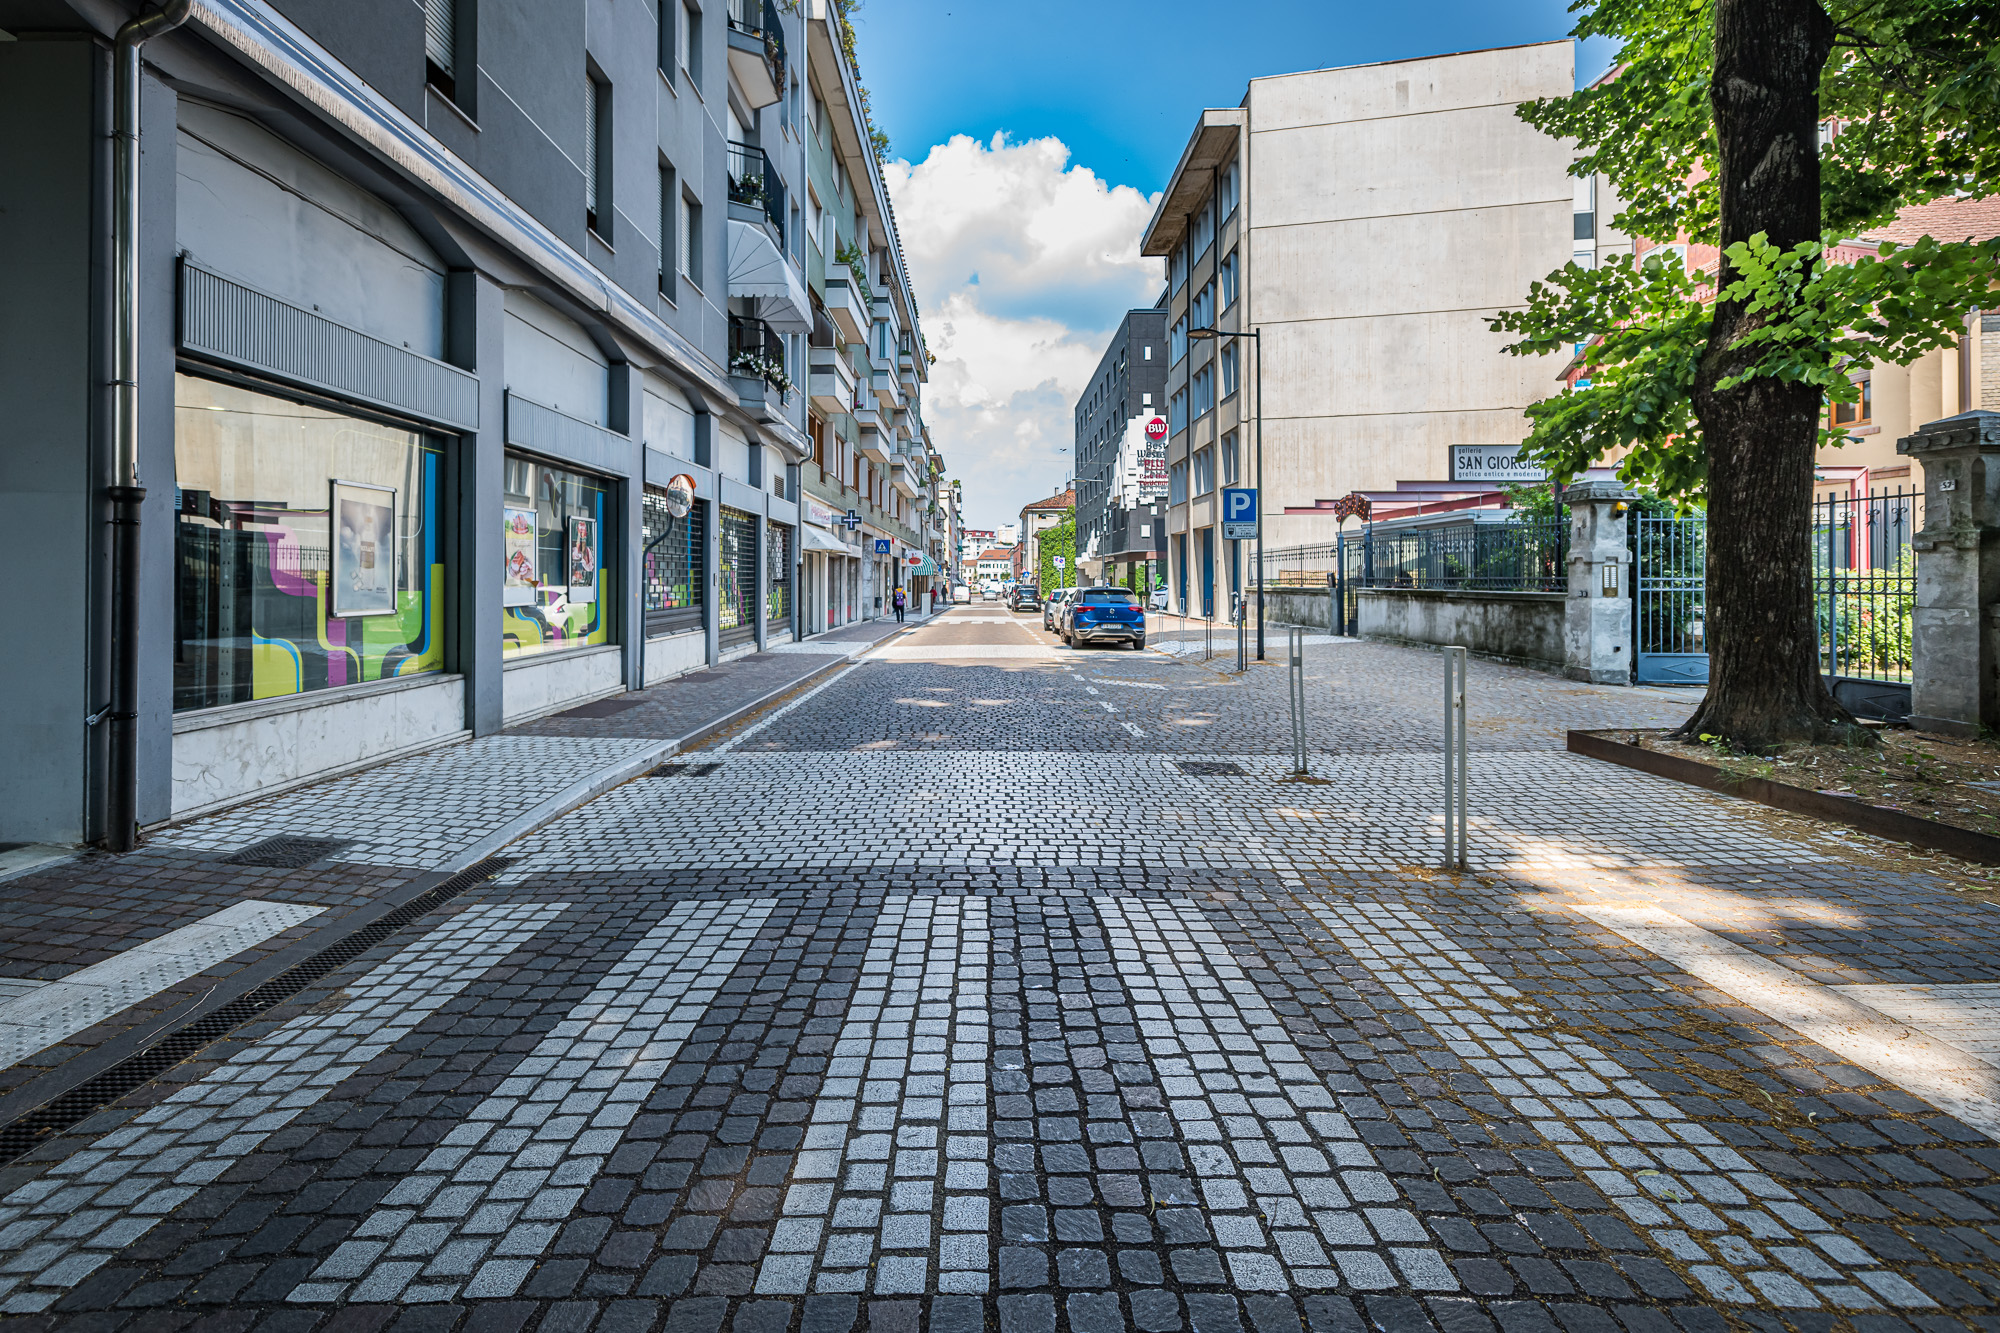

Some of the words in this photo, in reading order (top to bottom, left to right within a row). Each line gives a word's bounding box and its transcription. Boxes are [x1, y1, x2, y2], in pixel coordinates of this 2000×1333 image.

[1148, 423, 1166, 434] BW
[1146, 442, 1166, 450] Best
[1136, 450, 1166, 458] Weste
[1458, 447, 1482, 455] galleria
[1144, 459, 1166, 468] PLU
[1458, 456, 1483, 470] SAN
[1458, 470, 1482, 479] grafica
[1484, 470, 1505, 478] antica
[1513, 470, 1542, 478] moderna
[1230, 492, 1251, 520] P
